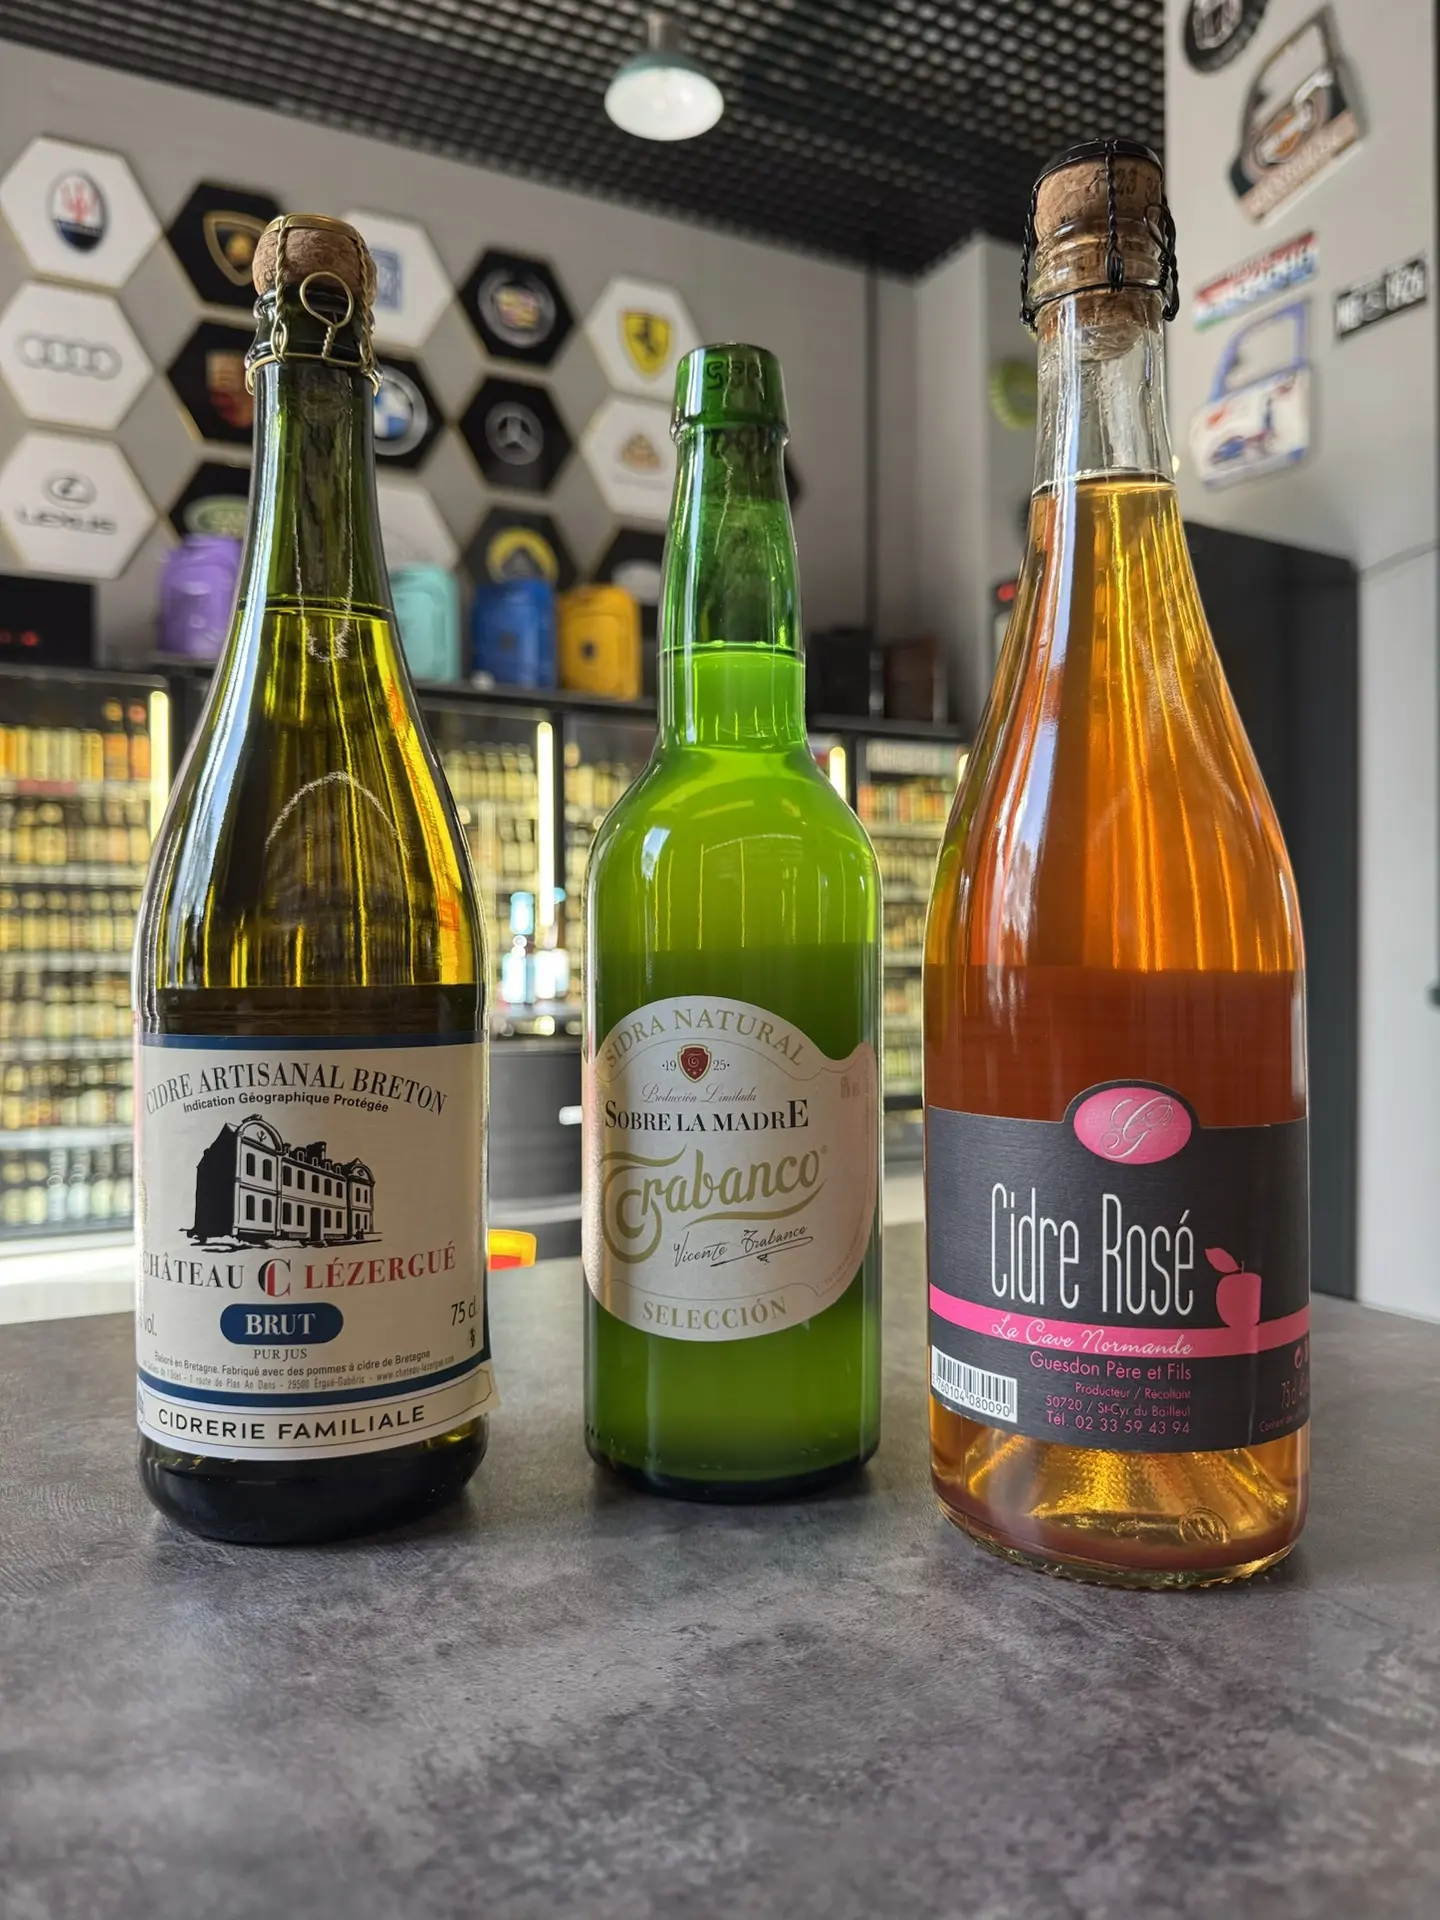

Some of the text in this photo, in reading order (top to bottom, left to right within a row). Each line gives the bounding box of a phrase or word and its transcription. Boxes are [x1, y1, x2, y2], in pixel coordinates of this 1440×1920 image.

[604, 1008, 805, 1068] SIDRA NATURAL
[146, 1062, 448, 1116] CIDRE ARTISANAL BRETON
[183, 1091, 389, 1113] Indication Géographique Protégée
[641, 1081, 758, 1104] Producción Limitada
[677, 1112, 706, 1132] LA
[673, 1226, 808, 1268] Vicente Trabanco
[991, 1182, 1079, 1309] Cidre
[1102, 1193, 1194, 1316] Rosé
[143, 1252, 246, 1290] CHÂTEAU
[304, 1241, 456, 1290] LÉZERGUÉ
[245, 1313, 316, 1336] BRUT
[451, 1301, 466, 1326] 75
[642, 1296, 788, 1331] SELECCIÓN
[991, 1313, 1194, 1355] La Cave Normande
[174, 1359, 183, 1369] en
[184, 1359, 220, 1375] Bretagne.
[221, 1364, 260, 1378] Fabriqué
[262, 1367, 285, 1377] avec
[287, 1365, 304, 1377] des
[306, 1363, 347, 1378] pommes
[348, 1361, 355, 1372] à
[356, 1357, 380, 1371] cidre
[382, 1356, 393, 1367] de
[395, 1350, 431, 1365] Bretagne
[254, 1349, 308, 1362] PUR JUS
[1029, 1350, 1192, 1381] Guesdon Père et Fils
[1075, 1383, 1130, 1399] Producteur
[1144, 1387, 1191, 1400] Récoltant
[969, 1394, 1010, 1417] 080090
[1045, 1394, 1082, 1412] 50720
[1097, 1402, 1130, 1418] St-Cyr
[1133, 1403, 1149, 1417] du
[1152, 1403, 1191, 1417] Bailleul
[158, 1404, 425, 1440] CIDRERIE FAMILIALE
[1046, 1409, 1190, 1435] Tél. 02 33 59 43 94
